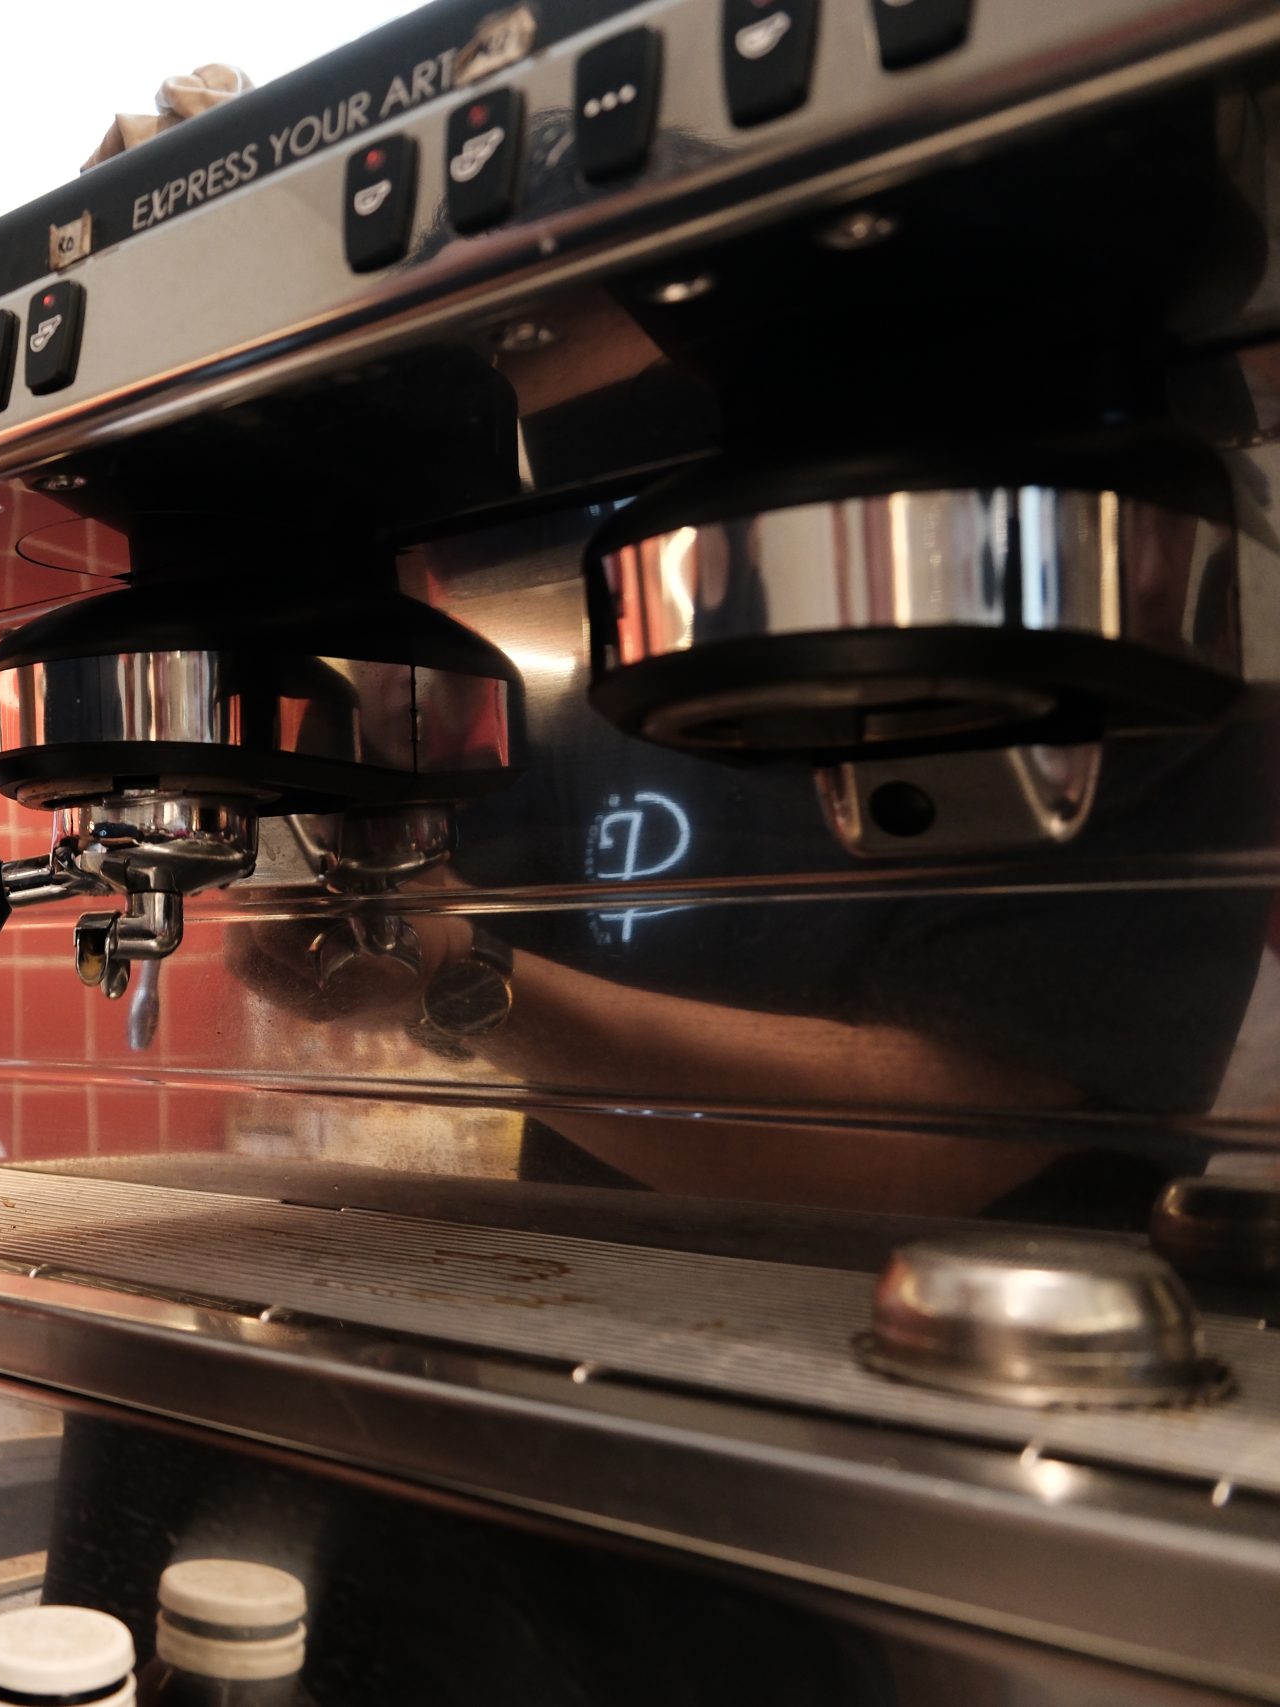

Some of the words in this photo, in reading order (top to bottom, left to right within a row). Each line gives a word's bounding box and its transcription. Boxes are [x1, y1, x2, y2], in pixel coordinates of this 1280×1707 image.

[132, 143, 259, 231] EXPRESS
[269, 91, 373, 165] YOUR
[380, 48, 457, 118] ART
